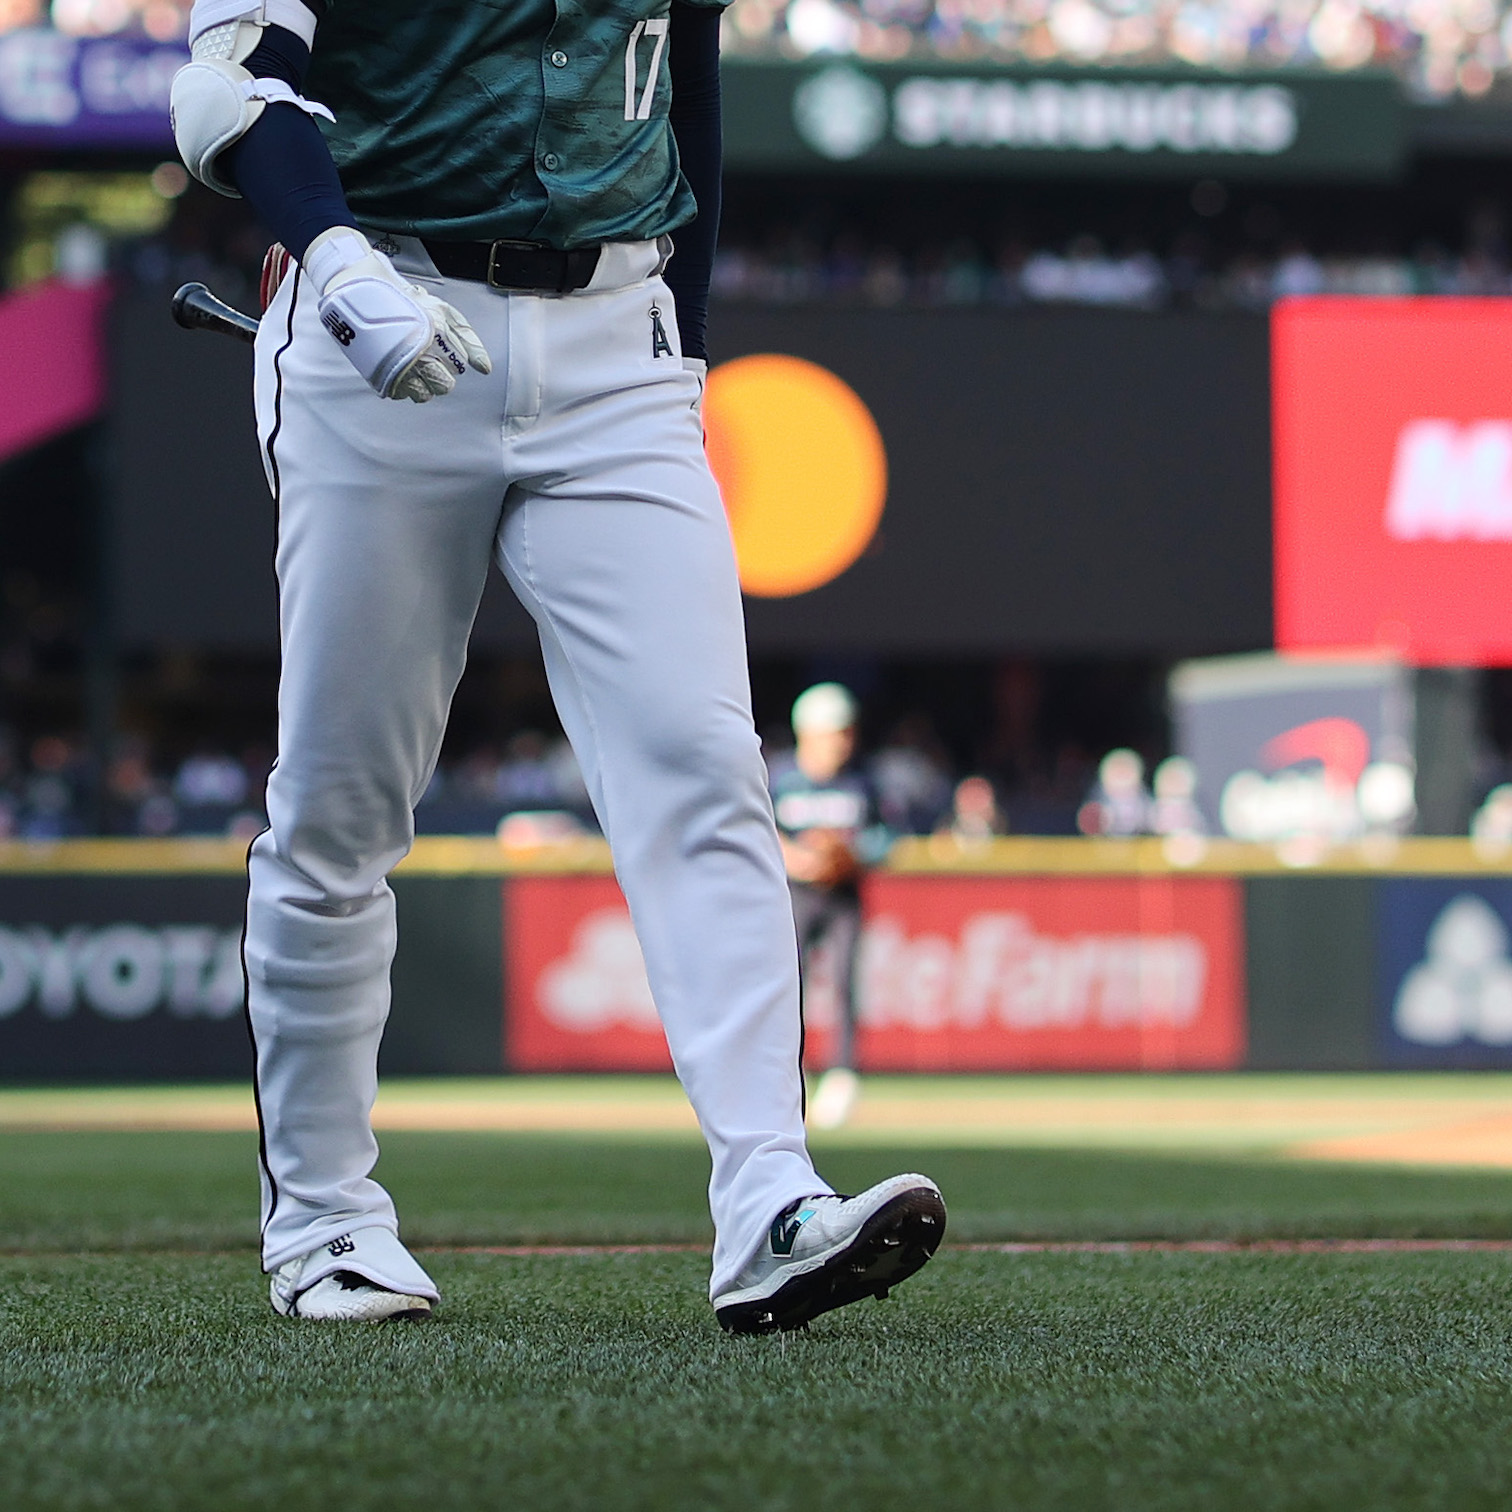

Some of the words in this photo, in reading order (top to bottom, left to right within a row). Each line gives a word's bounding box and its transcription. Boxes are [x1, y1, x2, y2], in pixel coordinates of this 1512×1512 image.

[624, 19, 670, 121] 17
[894, 77, 1296, 154] STARBUCKS
[434, 333, 451, 354] new
